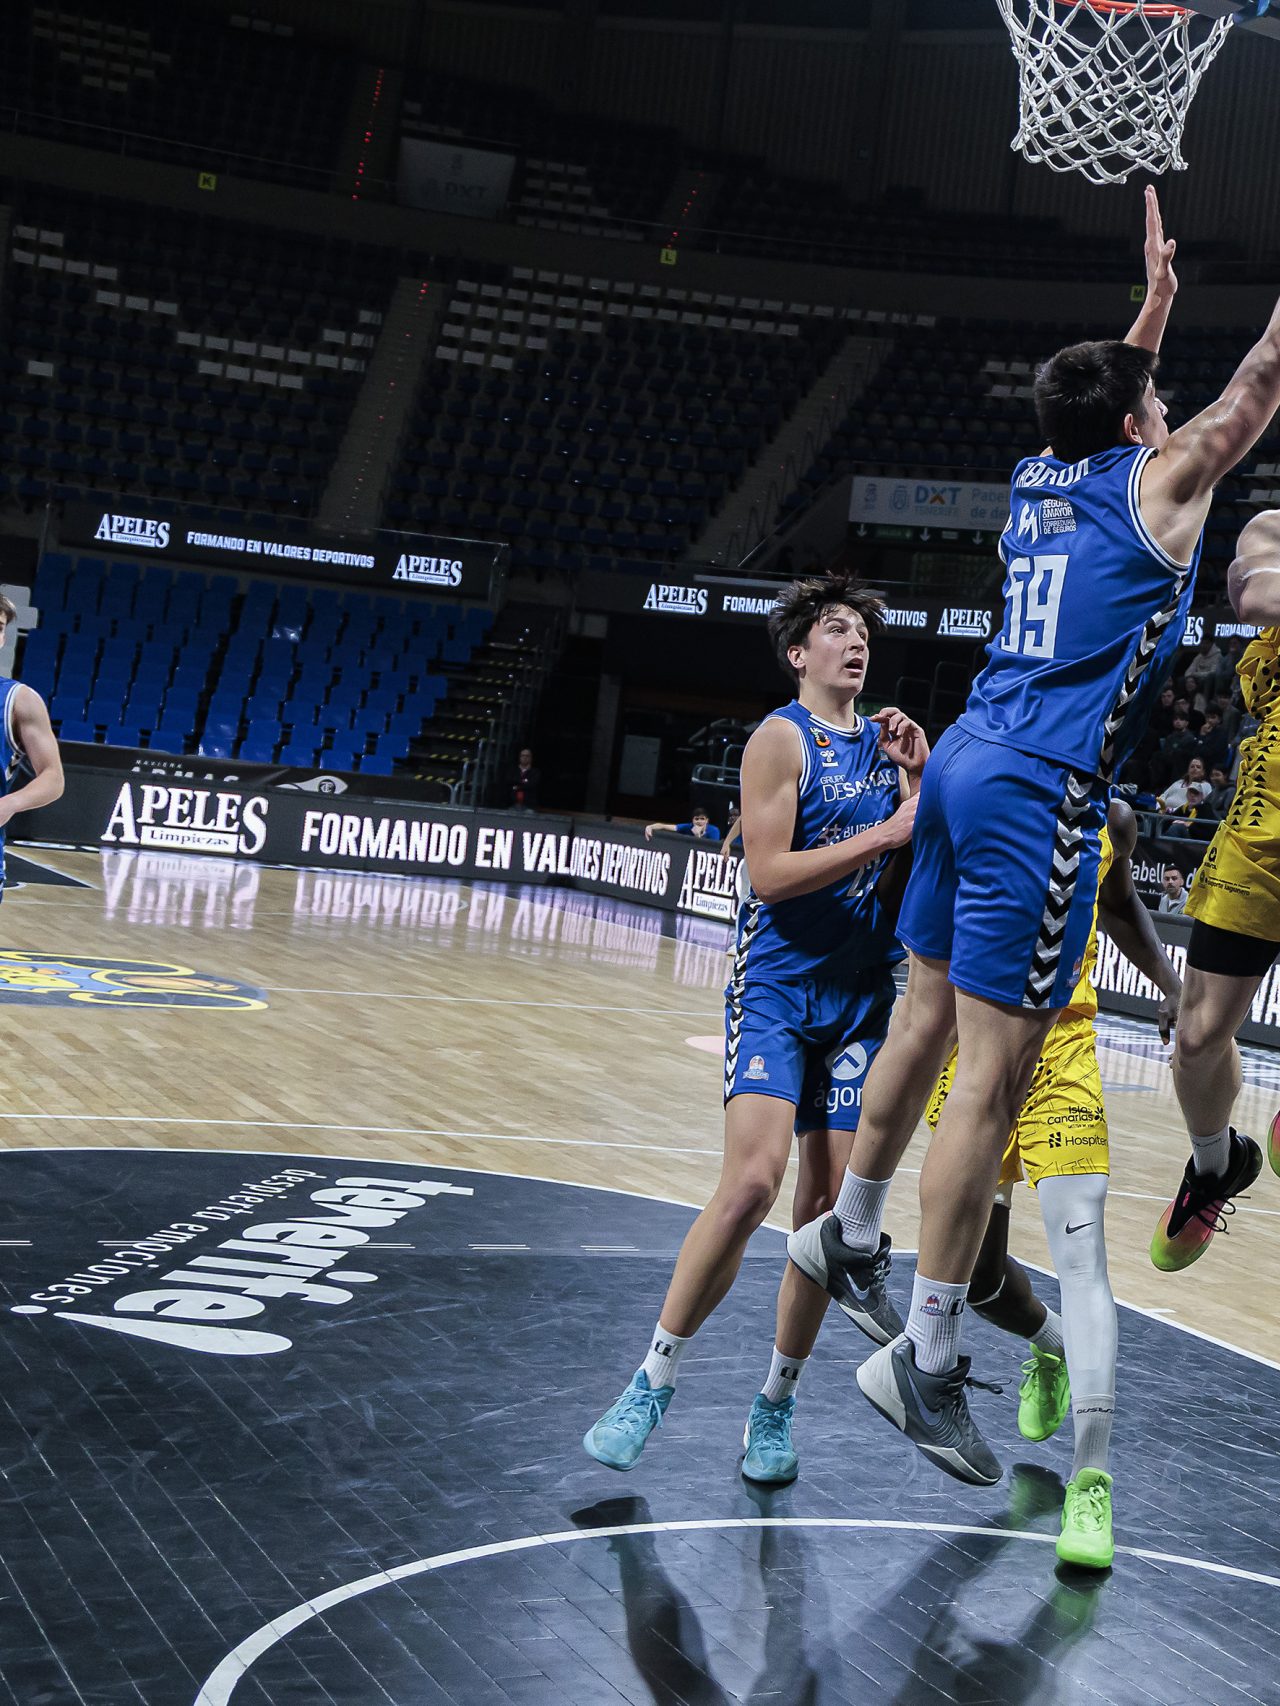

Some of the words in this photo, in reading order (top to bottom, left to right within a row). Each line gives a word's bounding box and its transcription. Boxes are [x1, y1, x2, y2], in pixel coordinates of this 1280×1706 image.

[94, 513, 171, 548] APELES
[187, 531, 245, 551] FORMANDO
[246, 540, 262, 553] EN
[263, 542, 312, 560] VALORES
[312, 549, 375, 569] DEPORTIVOS
[392, 554, 463, 587] APELES
[643, 584, 709, 615] APELES
[937, 608, 992, 637] APELES
[100, 781, 270, 855] APELES
[150, 829, 230, 847] Limpiezas
[301, 810, 469, 867] FORMANDO
[474, 827, 514, 871] EN
[522, 832, 602, 882] VALORES
[600, 842, 671, 897] DEPORTIVOS
[814, 1082, 863, 1114] ágor
[192, 1167, 328, 1222] despierta
[30, 1222, 209, 1305] emociones
